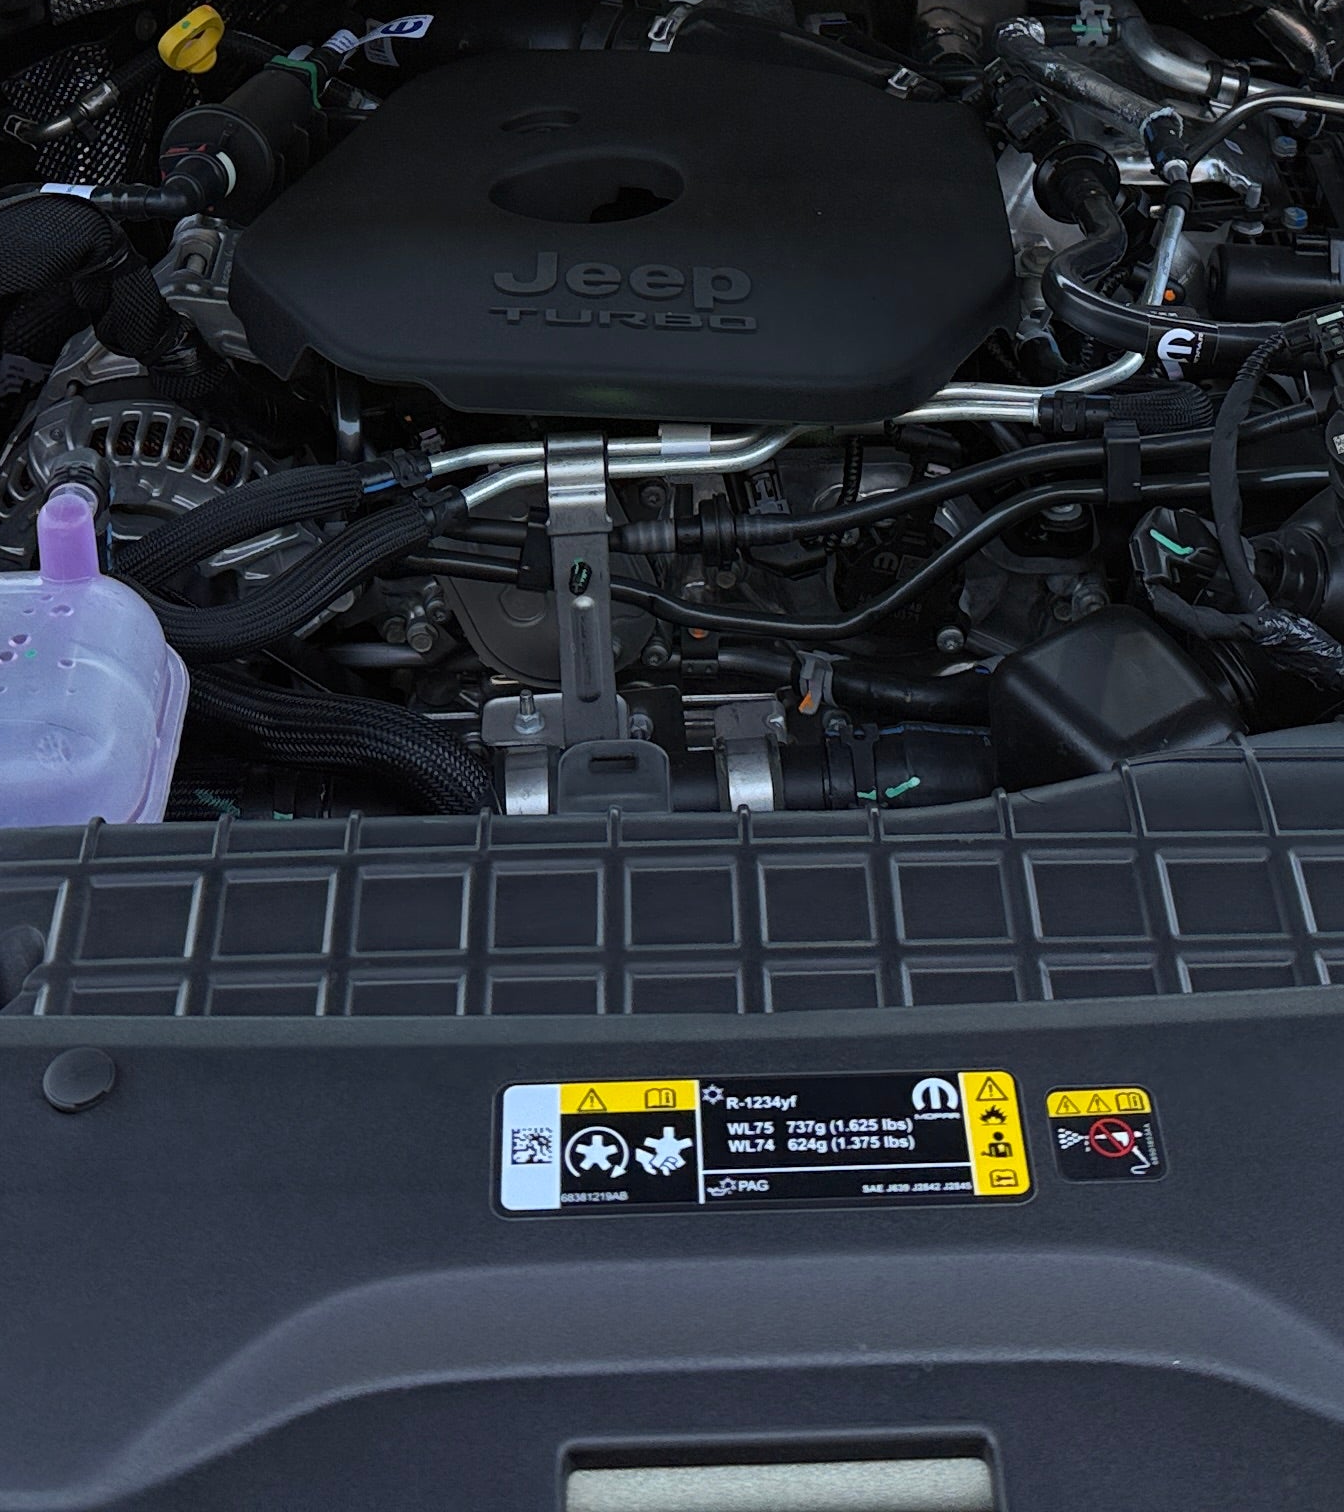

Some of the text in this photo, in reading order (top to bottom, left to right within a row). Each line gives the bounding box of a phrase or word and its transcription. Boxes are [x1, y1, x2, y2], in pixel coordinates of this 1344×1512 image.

[492, 251, 752, 311] Jeep
[488, 307, 757, 333] TURBO
[725, 1094, 799, 1112] R-1234yf
[727, 1117, 914, 1136] WL75 737g (1.625 lbs)
[728, 1134, 916, 1154] WL74 624g (1.375 lbs)
[737, 1179, 770, 1192] PAG
